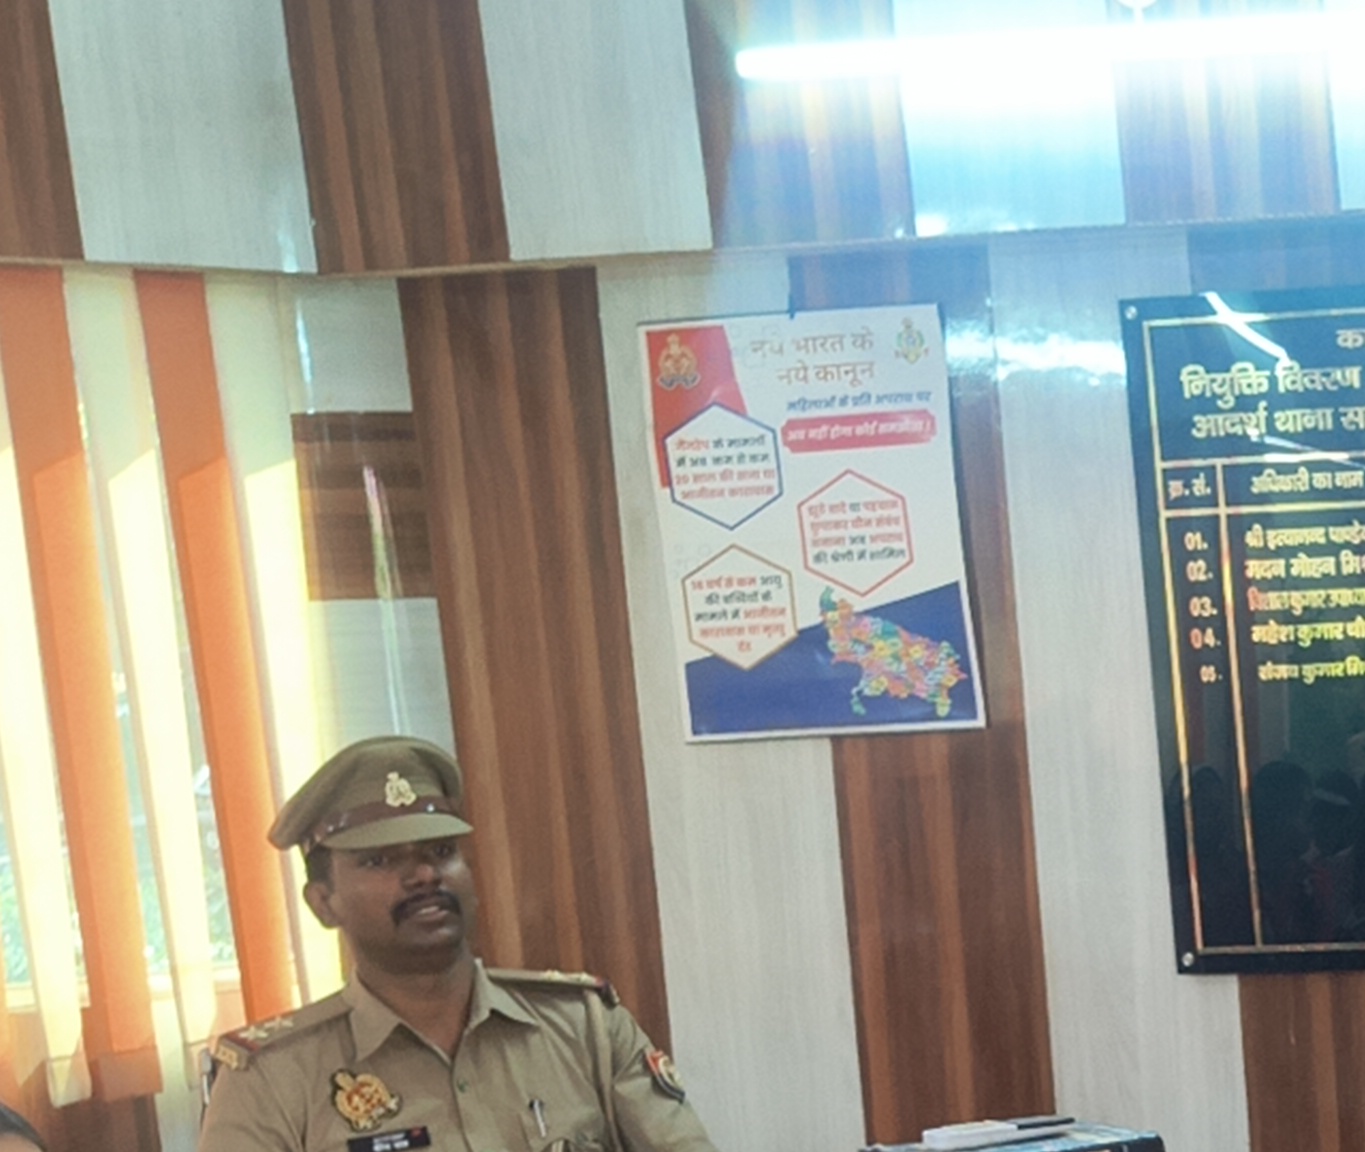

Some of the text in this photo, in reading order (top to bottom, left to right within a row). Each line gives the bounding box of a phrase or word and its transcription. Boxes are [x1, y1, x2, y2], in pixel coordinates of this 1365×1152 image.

[792, 333, 845, 354] भारत
[850, 326, 874, 351] के
[777, 360, 876, 387] नये कानून
[1180, 361, 1271, 409] नियुक्ति
[1275, 359, 1361, 393] विवरण
[1191, 401, 1267, 438] आदर्श
[1274, 408, 1334, 433] थाना
[1251, 466, 1364, 494] अधिकारी का नाम
[1184, 531, 1209, 551] 01.
[1245, 523, 1264, 548] श्री
[1186, 559, 1214, 582] 02.
[1244, 558, 1286, 580] मदन
[1290, 552, 1336, 579] मोहन
[1189, 596, 1218, 618] 03.
[1251, 618, 1295, 645] महेश
[1296, 622, 1344, 647] कुमार
[1302, 661, 1345, 685] कुमार
